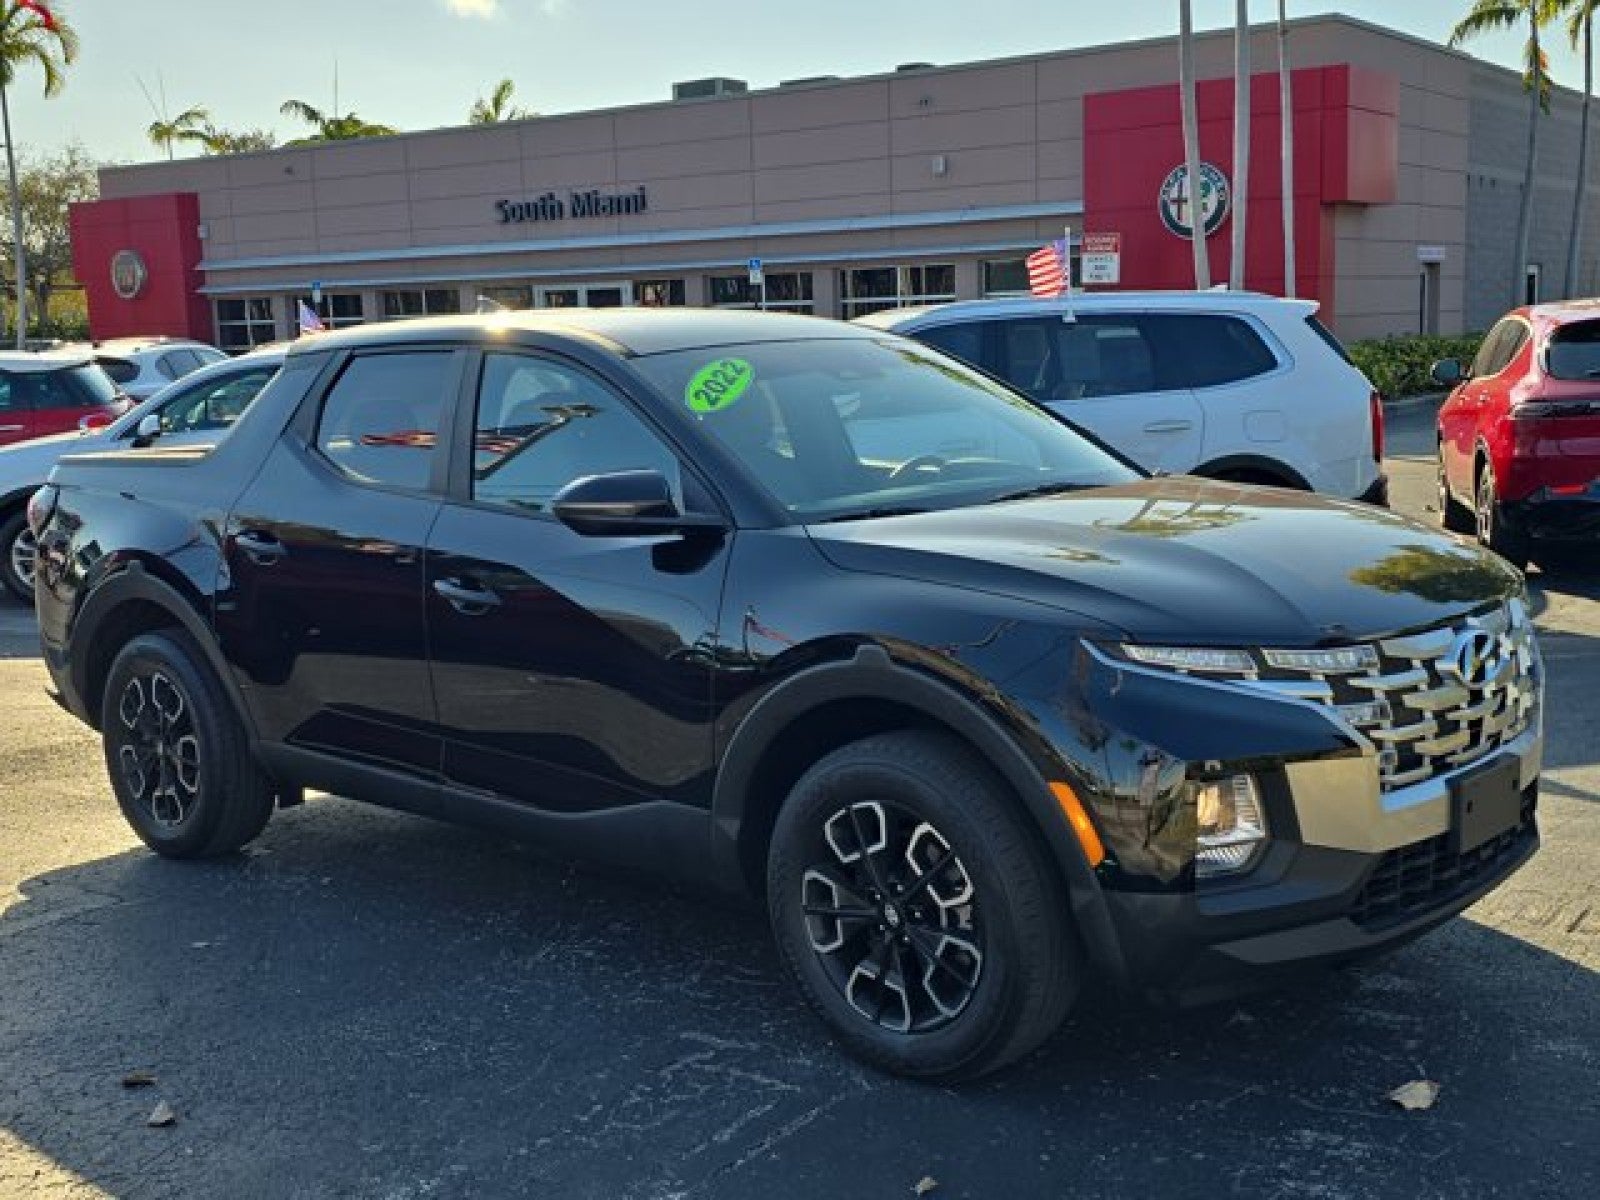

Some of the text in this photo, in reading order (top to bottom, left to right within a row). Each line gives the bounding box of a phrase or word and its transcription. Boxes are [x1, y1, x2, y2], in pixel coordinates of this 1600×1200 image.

[496, 184, 646, 223] South Miami
[693, 361, 746, 406] 2022
